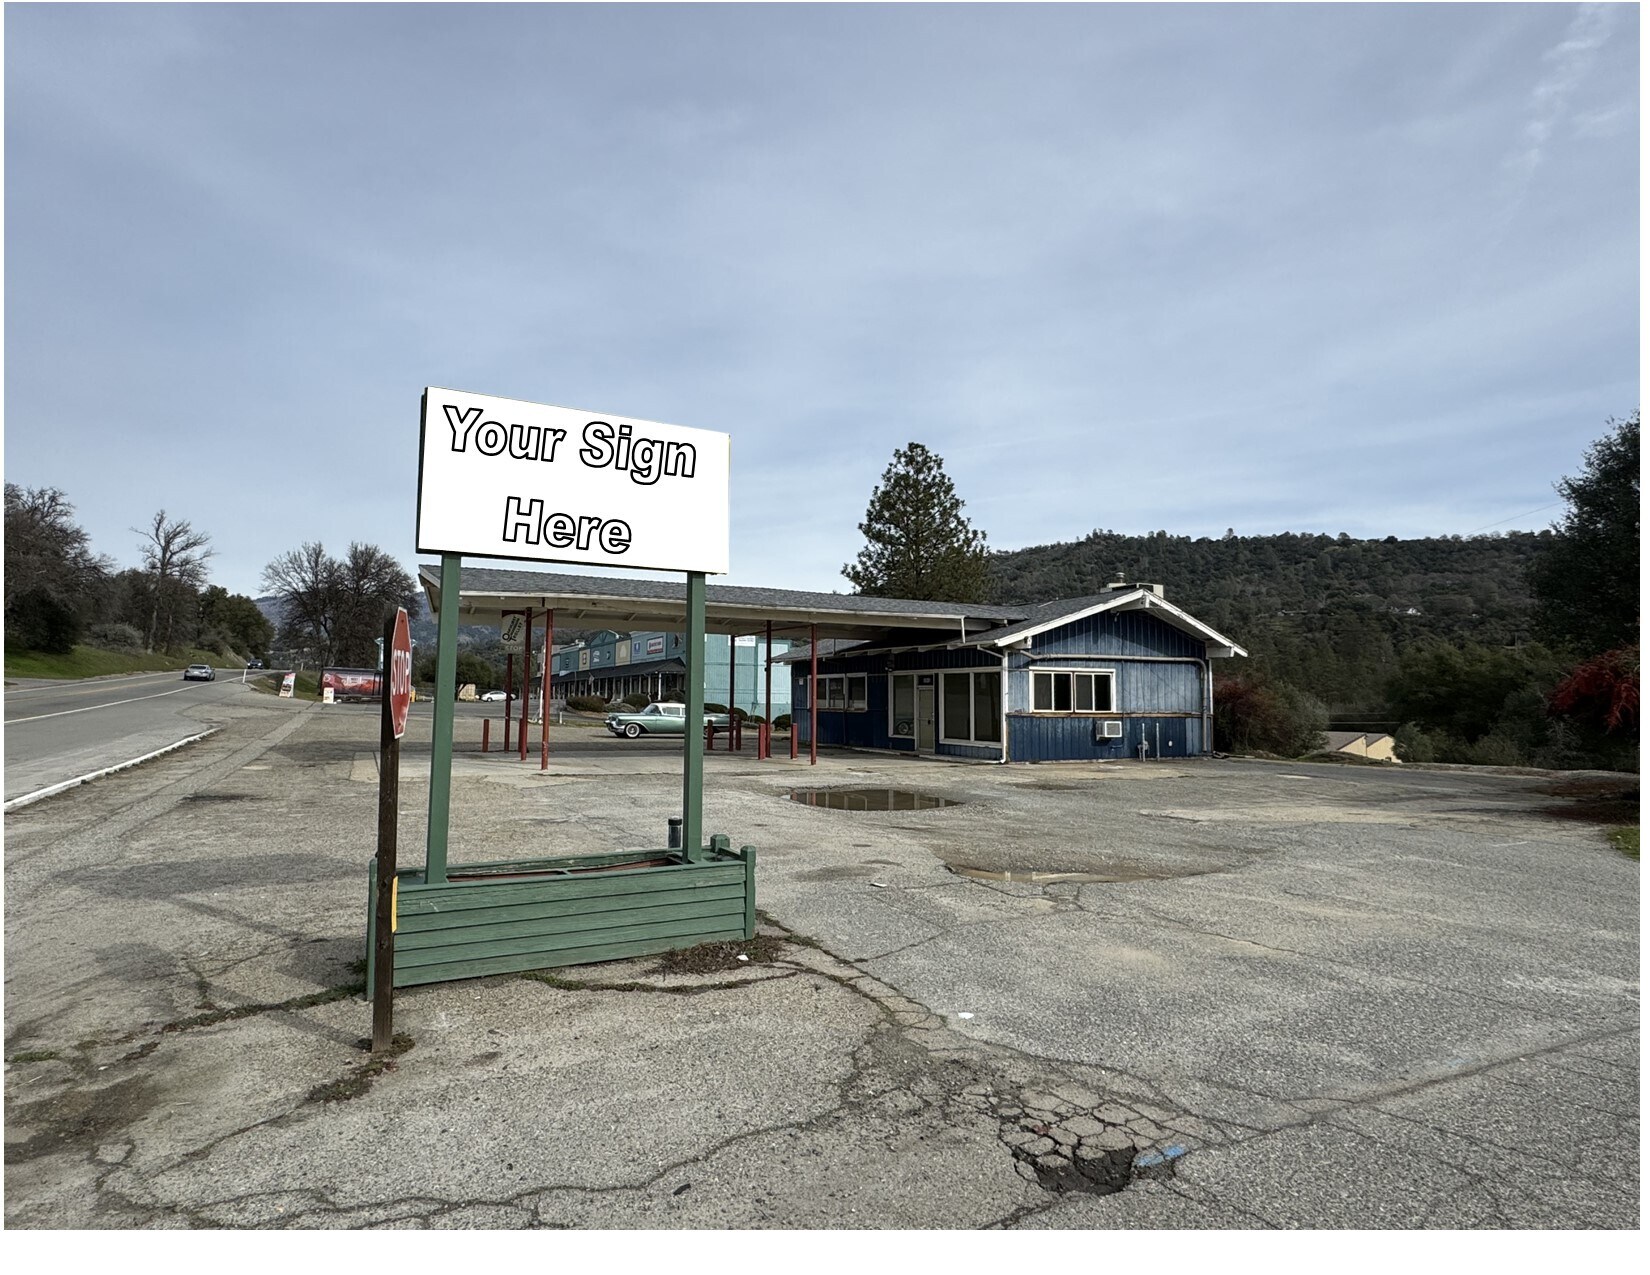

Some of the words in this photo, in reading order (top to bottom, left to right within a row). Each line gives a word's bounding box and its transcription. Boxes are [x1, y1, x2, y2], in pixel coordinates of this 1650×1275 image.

[442, 404, 568, 463] Your
[579, 420, 697, 486] Sign
[502, 495, 632, 554] Here
[392, 649, 410, 695] STOP
